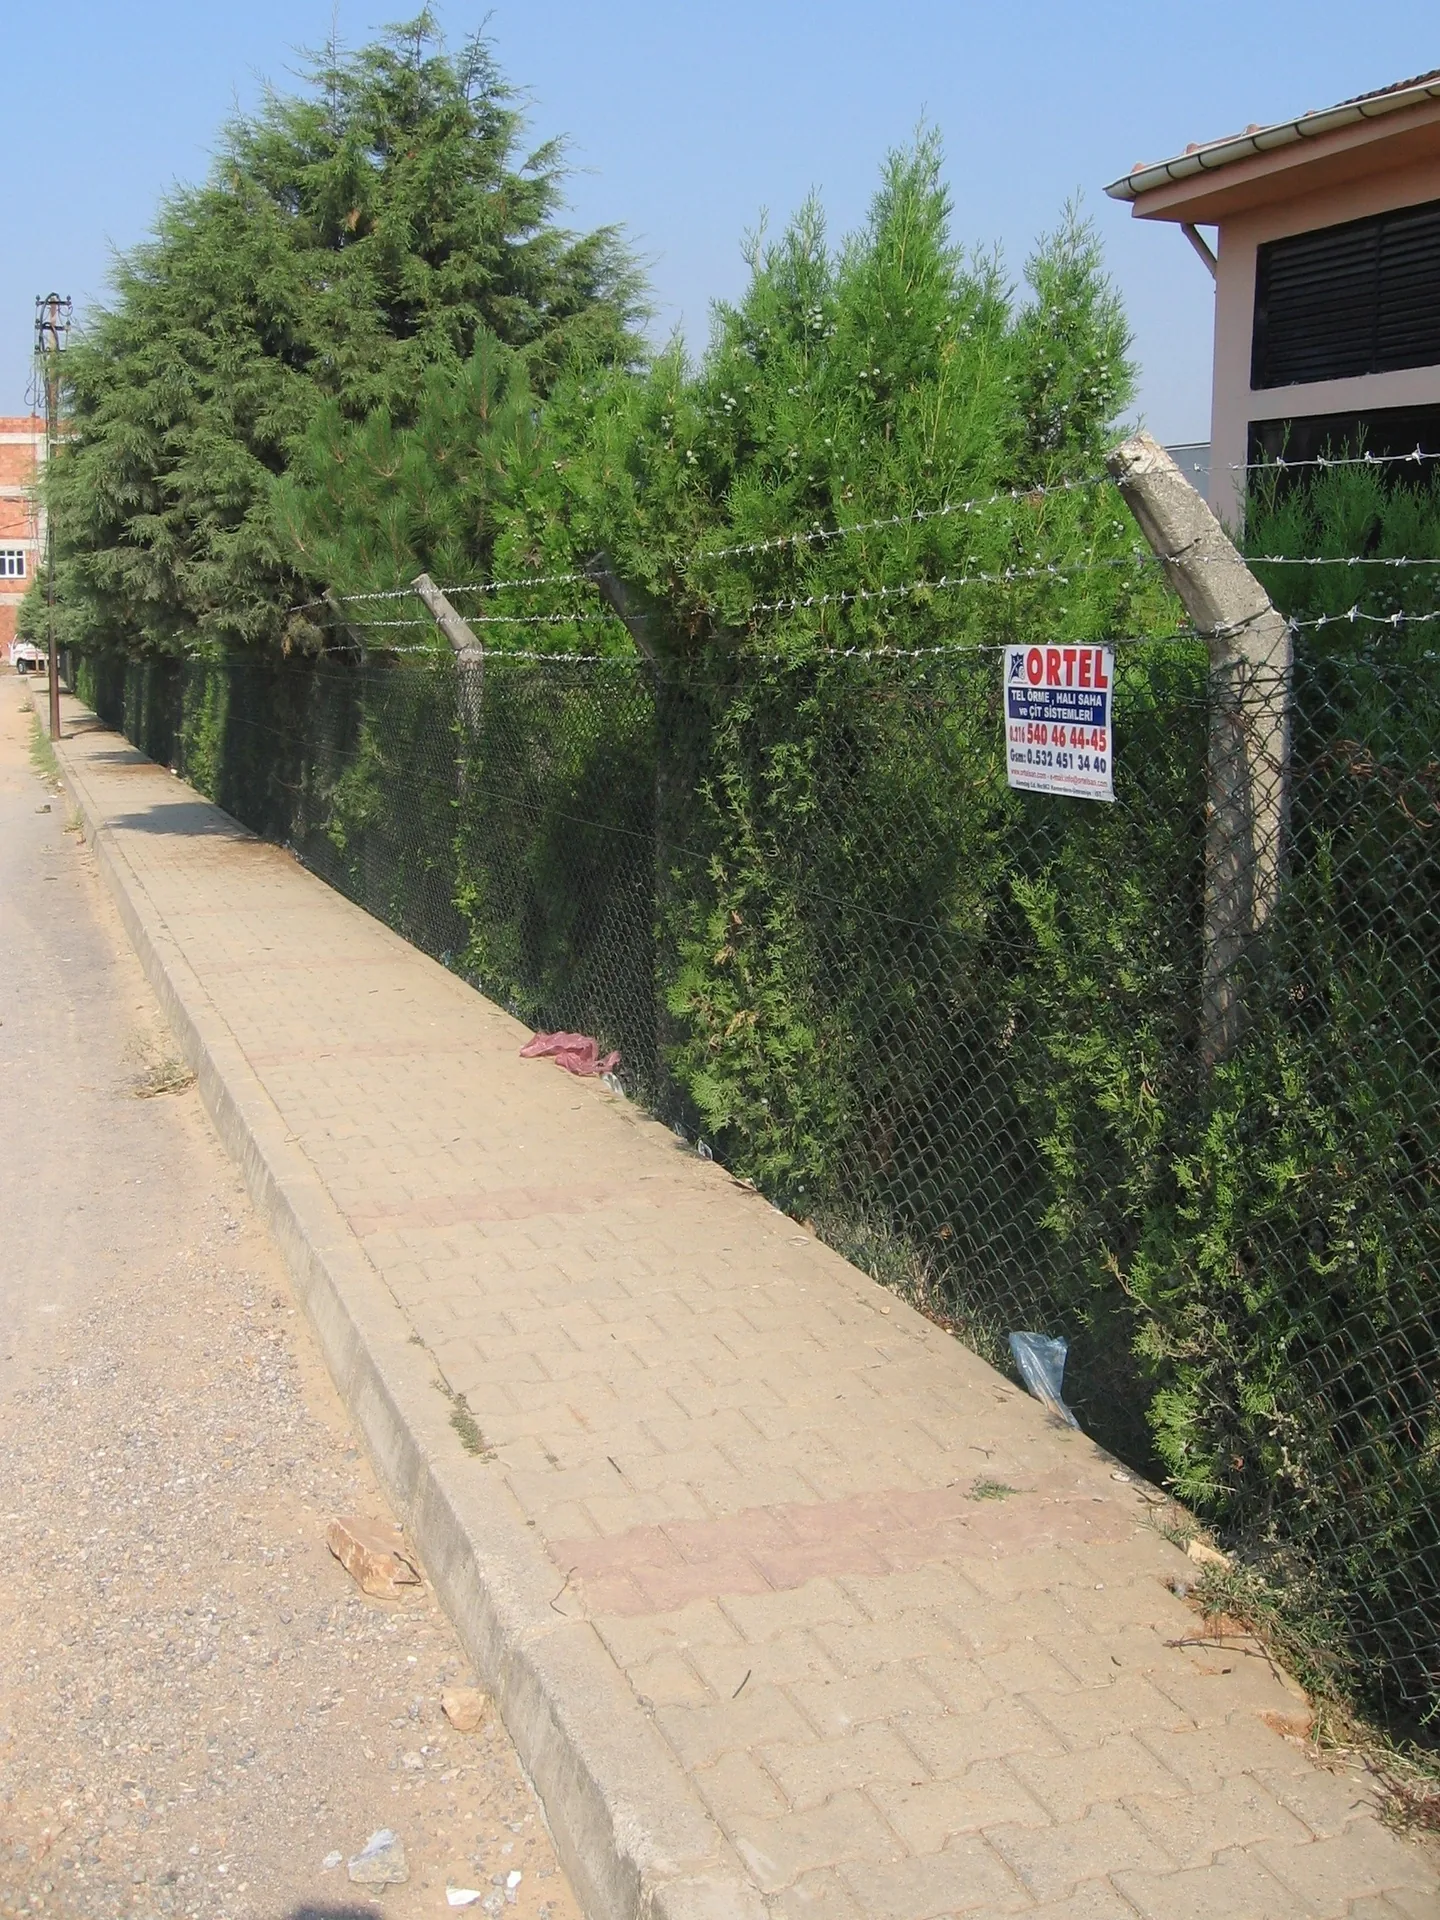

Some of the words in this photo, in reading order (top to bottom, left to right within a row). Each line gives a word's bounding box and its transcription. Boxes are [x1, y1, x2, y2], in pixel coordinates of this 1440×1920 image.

[1027, 648, 1108, 688] ORTEL
[1011, 689, 1026, 701] TEL
[1056, 692, 1076, 705] HALI
[1078, 694, 1102, 707] SAHA
[1018, 707, 1028, 716] ve
[1044, 705, 1093, 722] SİSTEMLERİ
[1010, 725, 1025, 743] 0.216
[1027, 723, 1047, 746] 540
[1051, 725, 1066, 747] 46
[1070, 727, 1107, 752] 44-45
[1027, 749, 1053, 767] 0.532
[1056, 752, 1073, 769] 451
[1077, 754, 1090, 771] 34
[1093, 756, 1106, 773] 40
